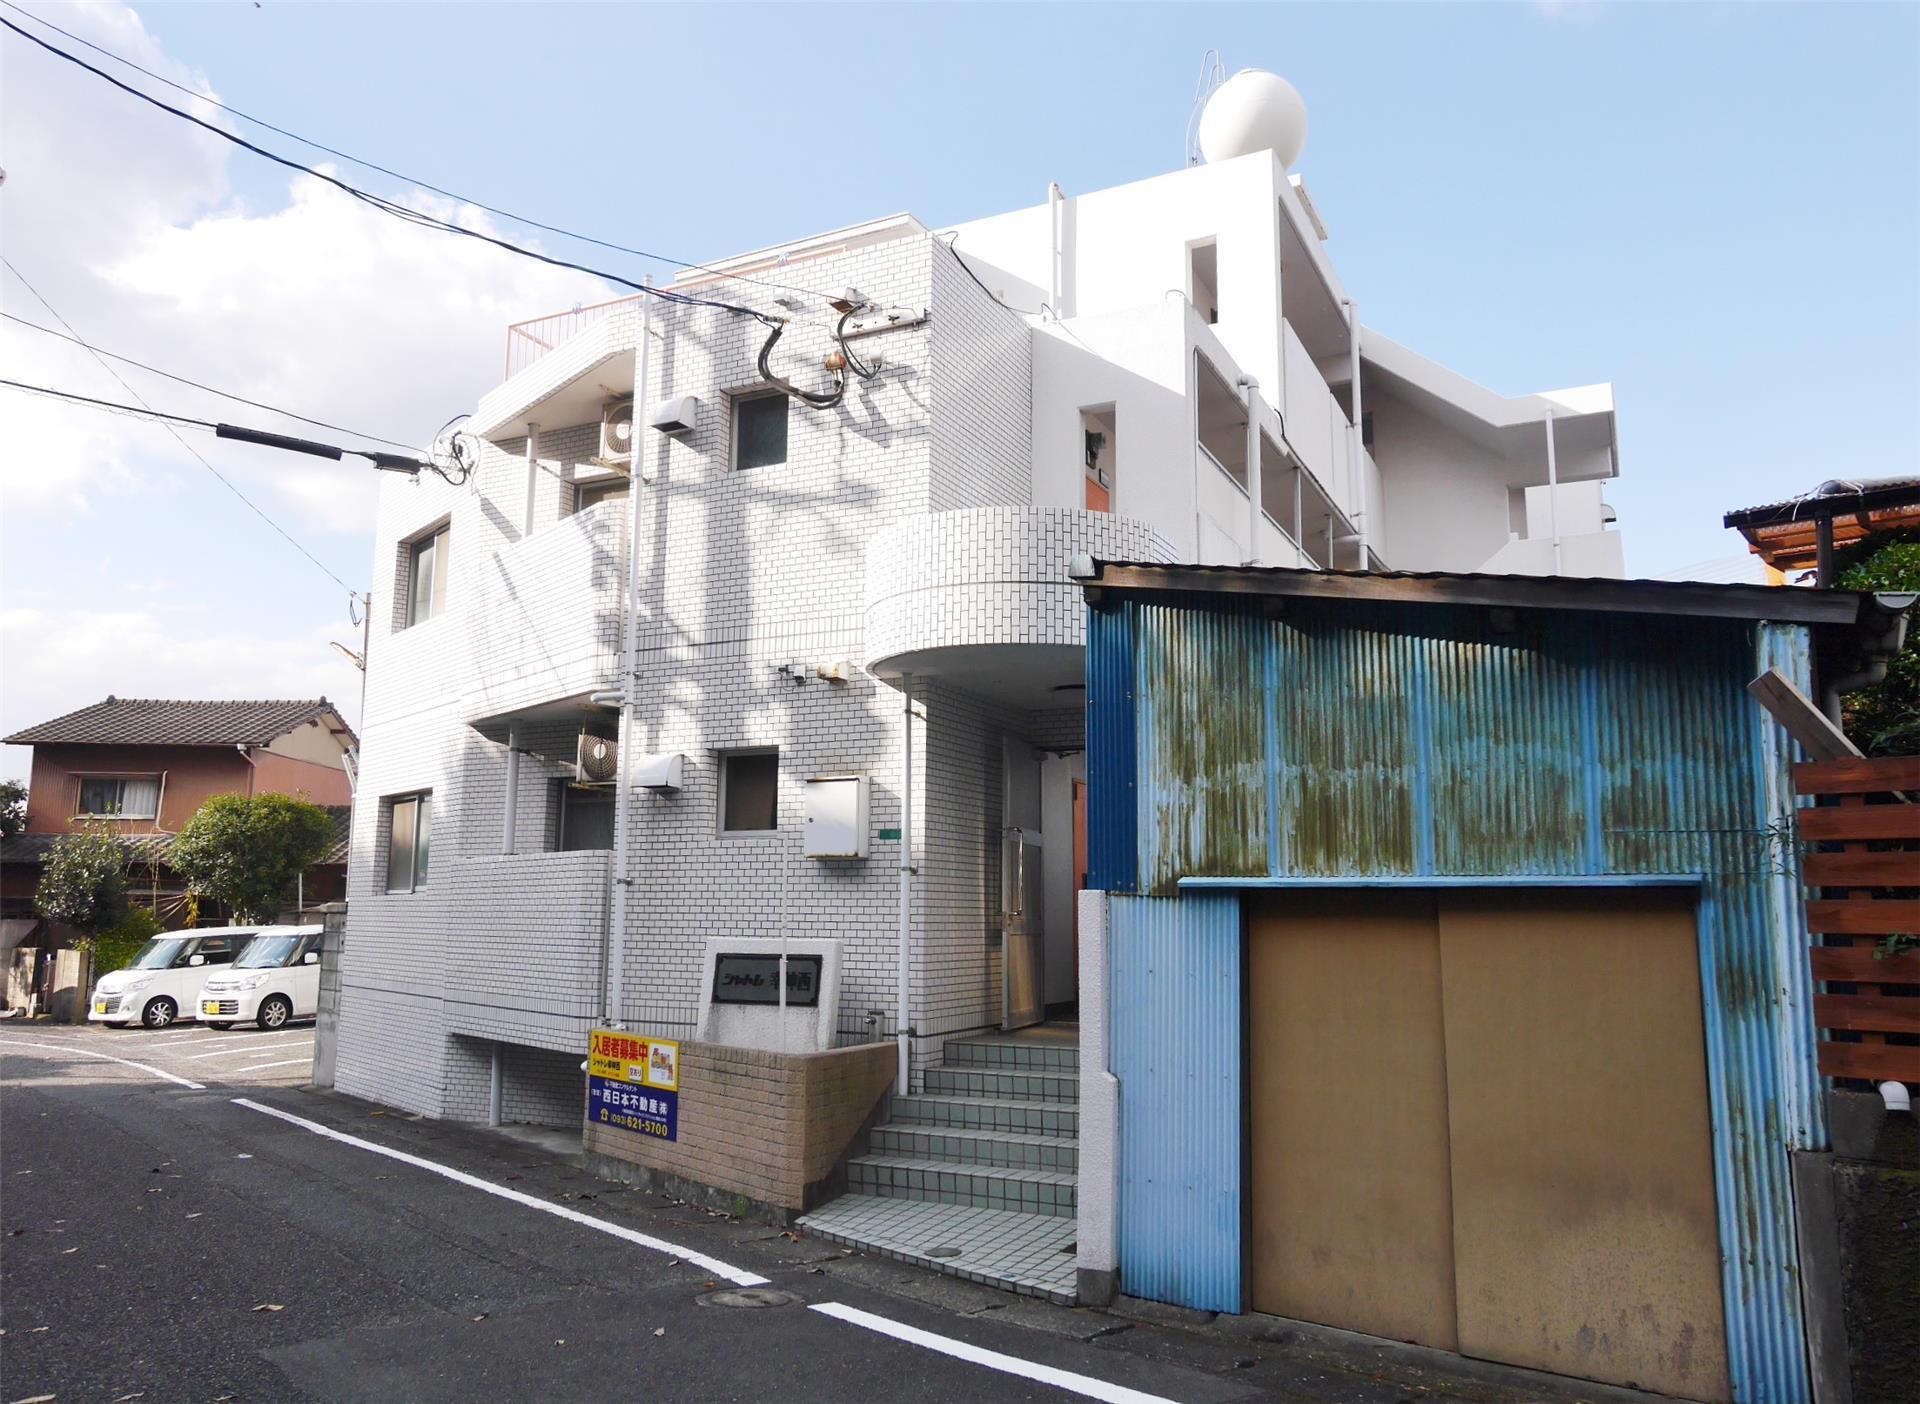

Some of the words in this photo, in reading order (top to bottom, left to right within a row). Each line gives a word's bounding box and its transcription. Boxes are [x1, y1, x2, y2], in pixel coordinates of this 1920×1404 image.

[592, 1035, 648, 1063] 入居者募集中
